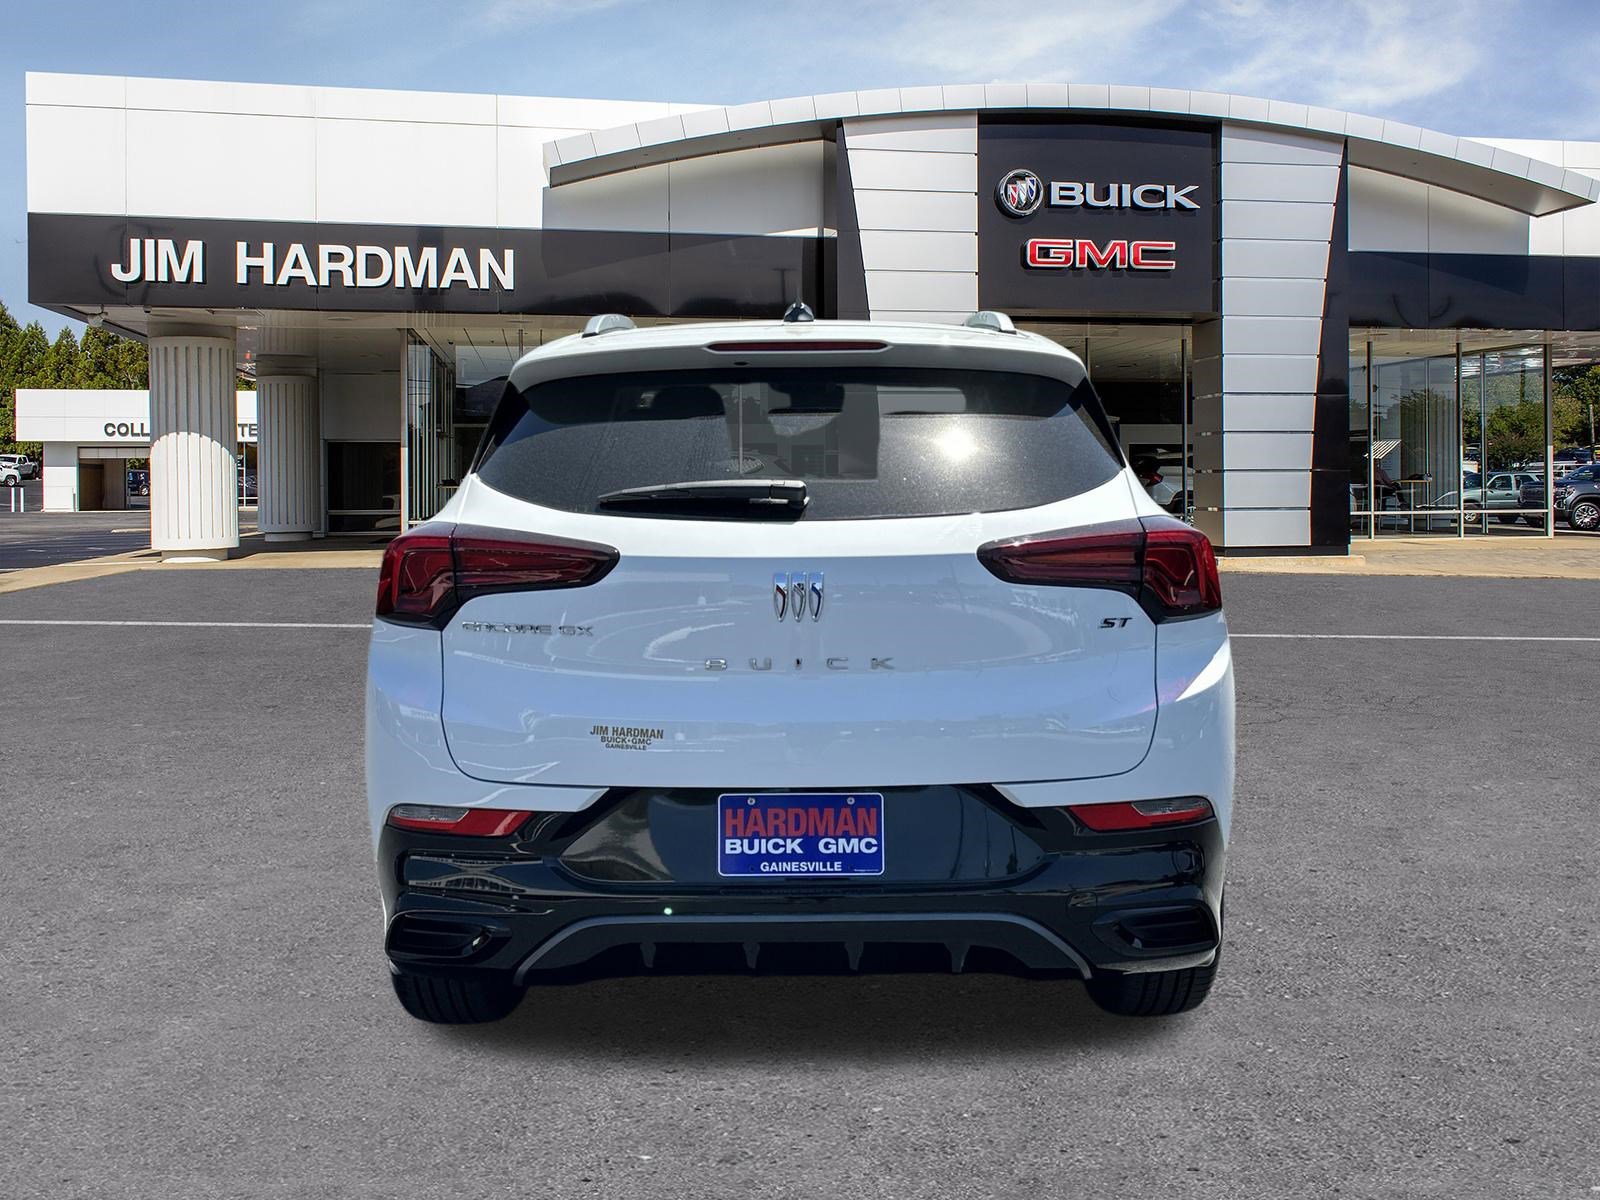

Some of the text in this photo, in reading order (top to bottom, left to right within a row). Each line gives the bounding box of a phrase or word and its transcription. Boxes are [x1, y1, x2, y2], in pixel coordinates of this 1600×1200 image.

[1049, 181, 1200, 209] BUICK
[1027, 238, 1176, 270] GMC
[110, 238, 516, 291] JIM HARDMAN
[1099, 617, 1133, 629] ST
[558, 625, 593, 637] GX
[704, 657, 896, 671] BUICK
[590, 725, 664, 739] JIM HARDMAN
[725, 807, 877, 837] HARDMAN
[725, 837, 878, 854] BUICK GMC
[760, 861, 842, 872] GAINESVILLE
